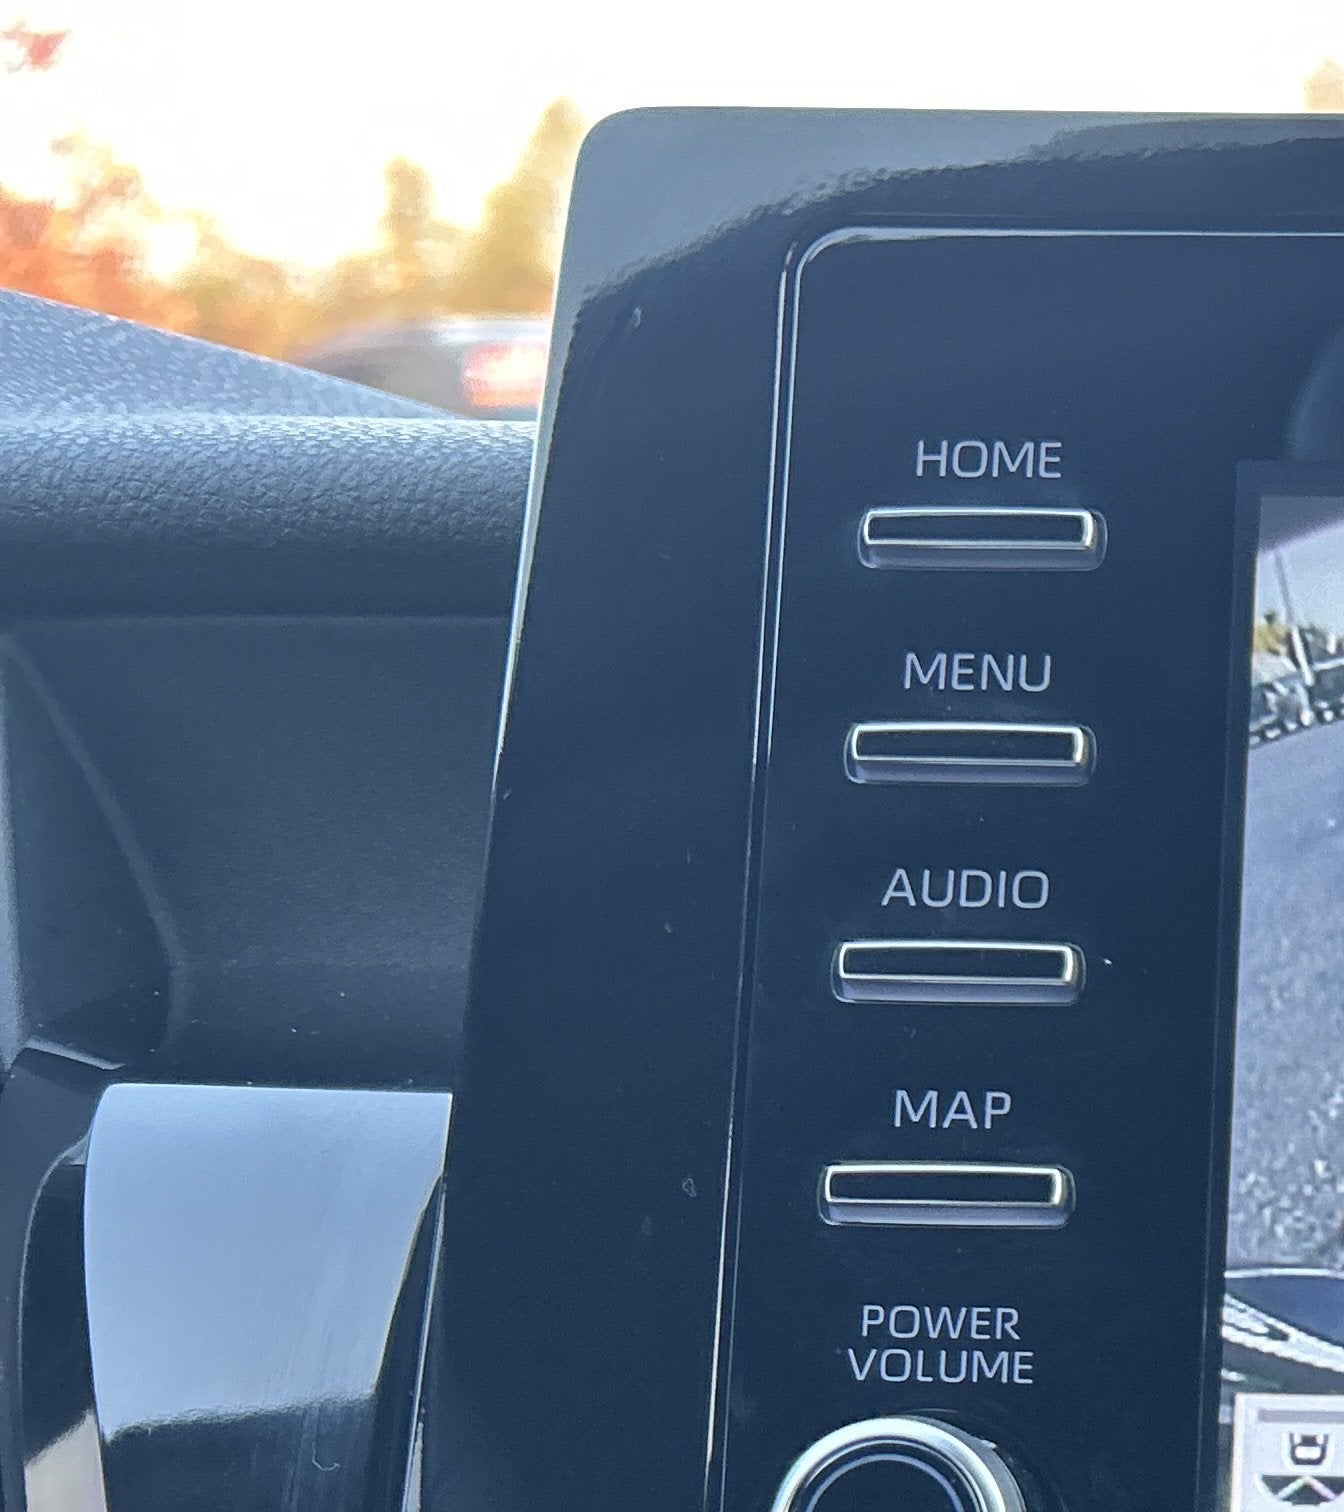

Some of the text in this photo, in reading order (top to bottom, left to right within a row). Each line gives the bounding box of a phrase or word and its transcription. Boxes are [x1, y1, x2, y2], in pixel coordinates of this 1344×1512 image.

[916, 439, 1062, 479] HOME
[904, 652, 1051, 692] MENU
[881, 868, 1049, 909] AUDIO
[894, 1089, 1011, 1129] MAP
[862, 1304, 1021, 1340] POWER
[847, 1348, 1034, 1384] VOLUME
